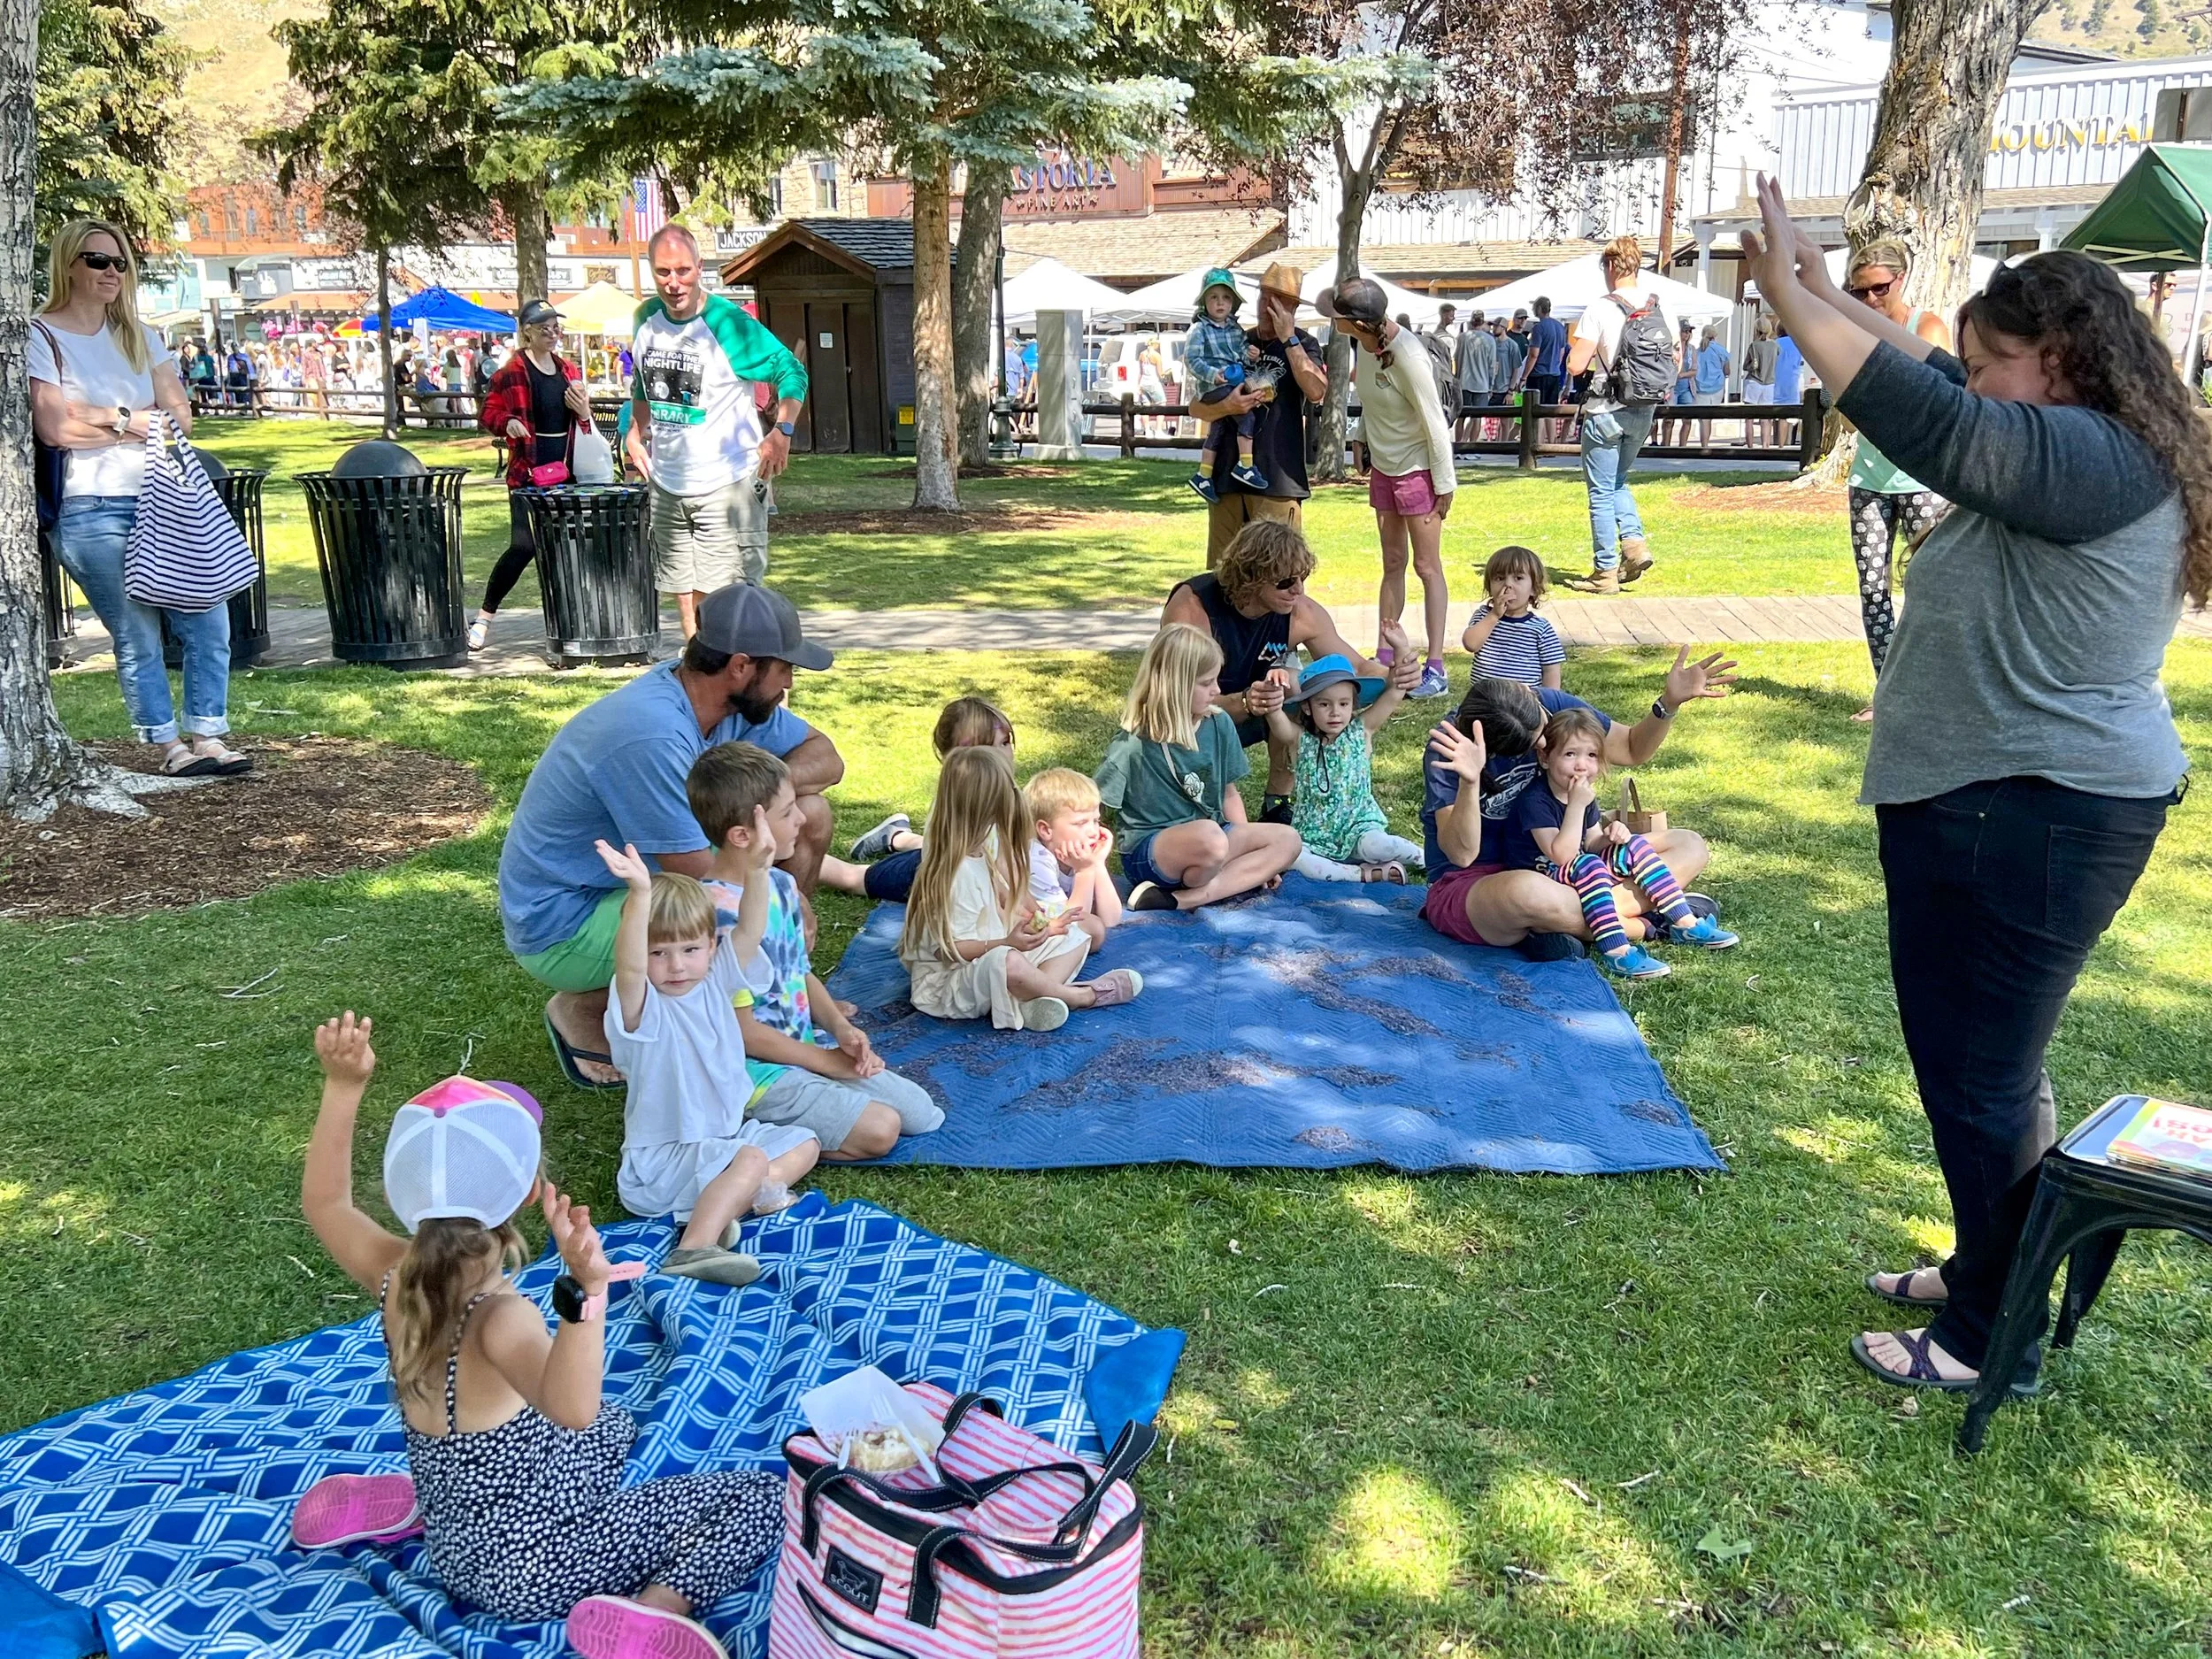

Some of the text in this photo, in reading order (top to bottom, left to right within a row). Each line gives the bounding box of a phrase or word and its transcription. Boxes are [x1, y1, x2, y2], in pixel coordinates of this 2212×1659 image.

[1986, 111, 2154, 151] OUNTAI
[1028, 195, 1087, 210] FINE ART
[647, 349, 699, 363] CAME FOR THE
[644, 357, 701, 374] NIGHTLIFE
[830, 1573, 869, 1602] SCOUT
